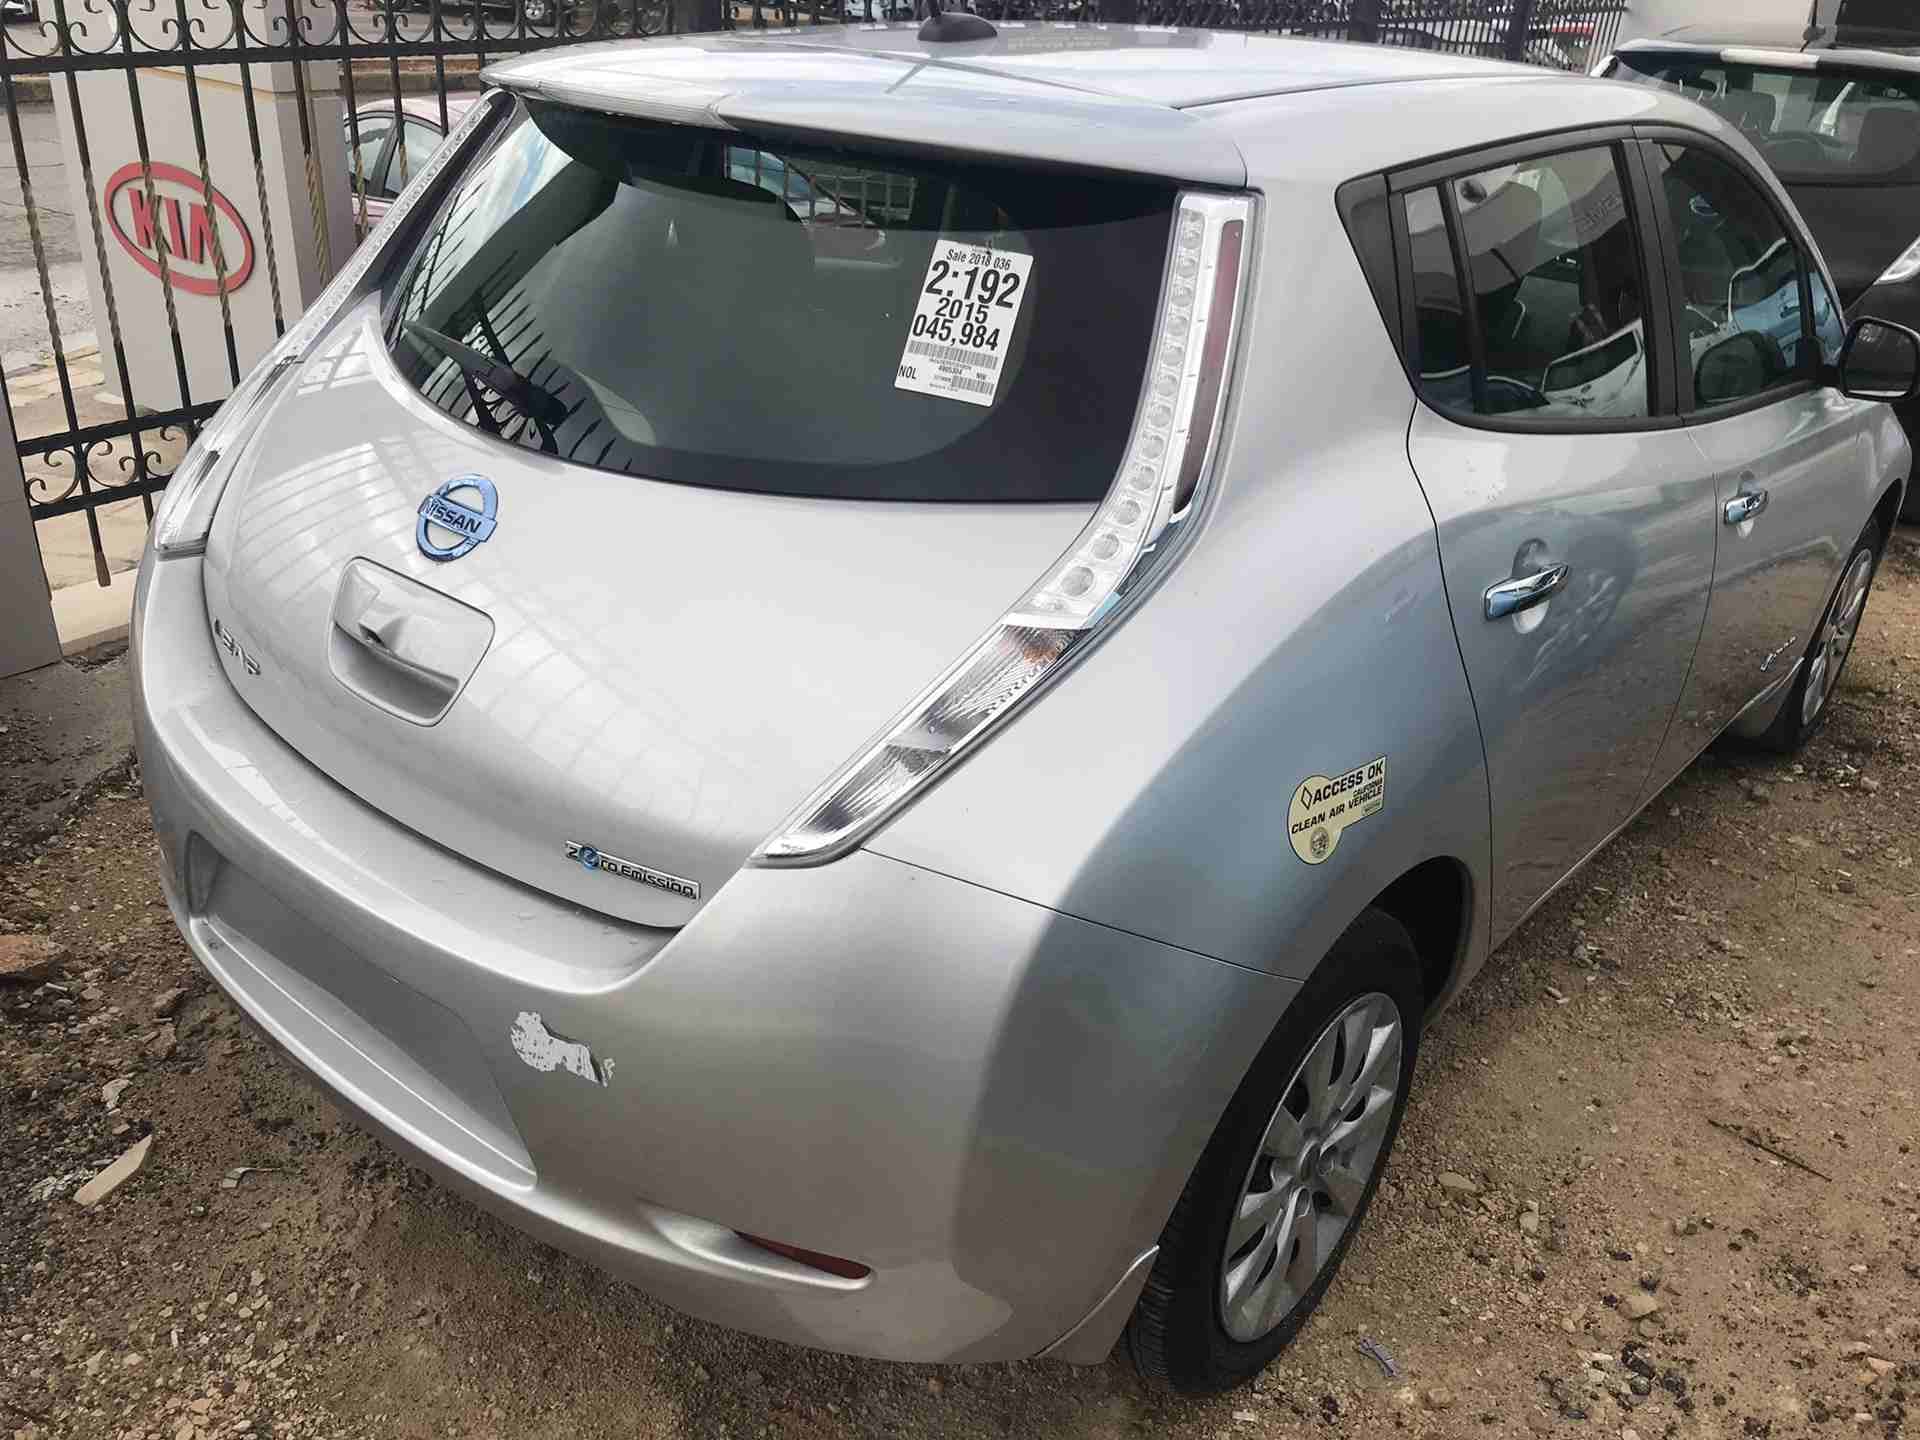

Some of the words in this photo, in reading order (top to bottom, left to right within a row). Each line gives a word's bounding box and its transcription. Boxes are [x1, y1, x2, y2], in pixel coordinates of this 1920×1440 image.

[128, 188, 227, 271] KIA
[947, 249, 966, 263] Sale
[969, 252, 992, 266] 2018
[994, 257, 1011, 270] 036
[925, 260, 1020, 308] 2:192
[936, 297, 989, 324] 2015
[912, 314, 1000, 351] 045,984
[898, 365, 917, 380] NOL
[424, 498, 482, 533] NISSAN
[1313, 770, 1363, 804] ACCESS
[1367, 761, 1384, 780] OK
[1291, 812, 1325, 834] CLEAN
[1329, 804, 1345, 819] AIR
[1348, 785, 1382, 809] VEHICLE
